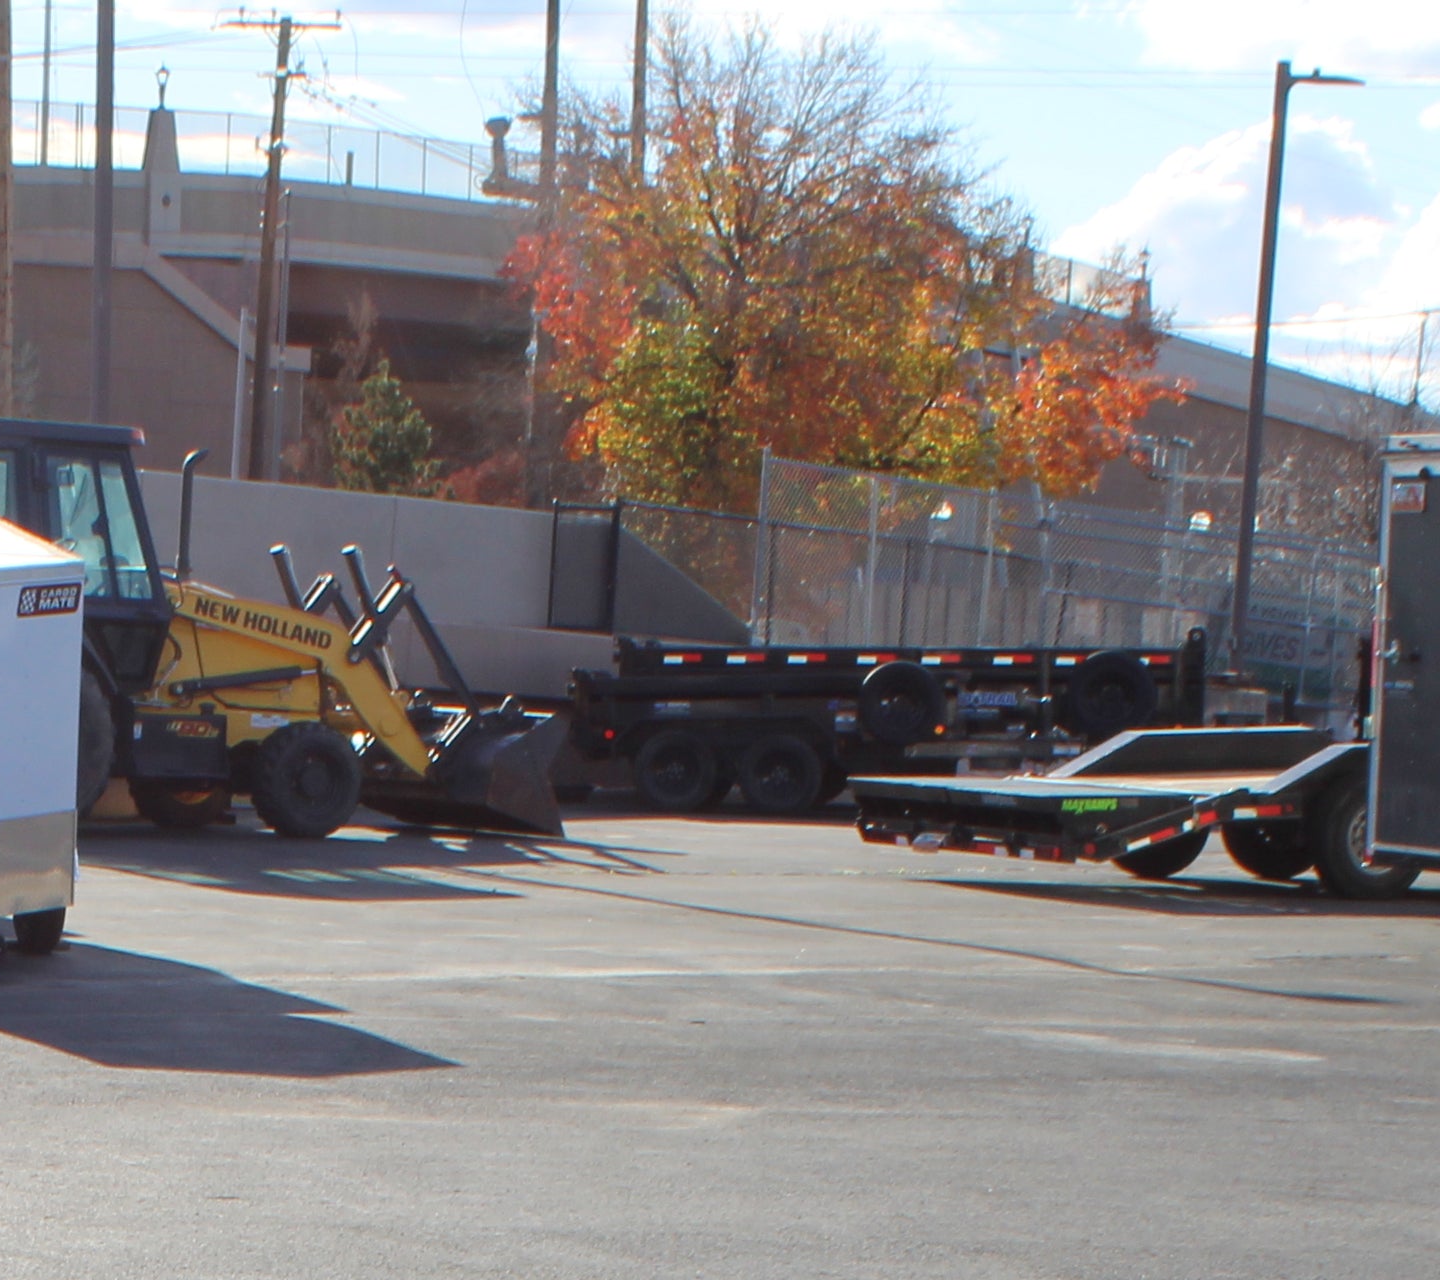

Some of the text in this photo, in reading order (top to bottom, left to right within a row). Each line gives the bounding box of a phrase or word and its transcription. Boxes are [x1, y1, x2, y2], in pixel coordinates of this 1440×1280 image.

[39, 586, 79, 599] CARGO
[38, 597, 76, 610] MATE
[193, 597, 333, 650] NEW HOLLAND
